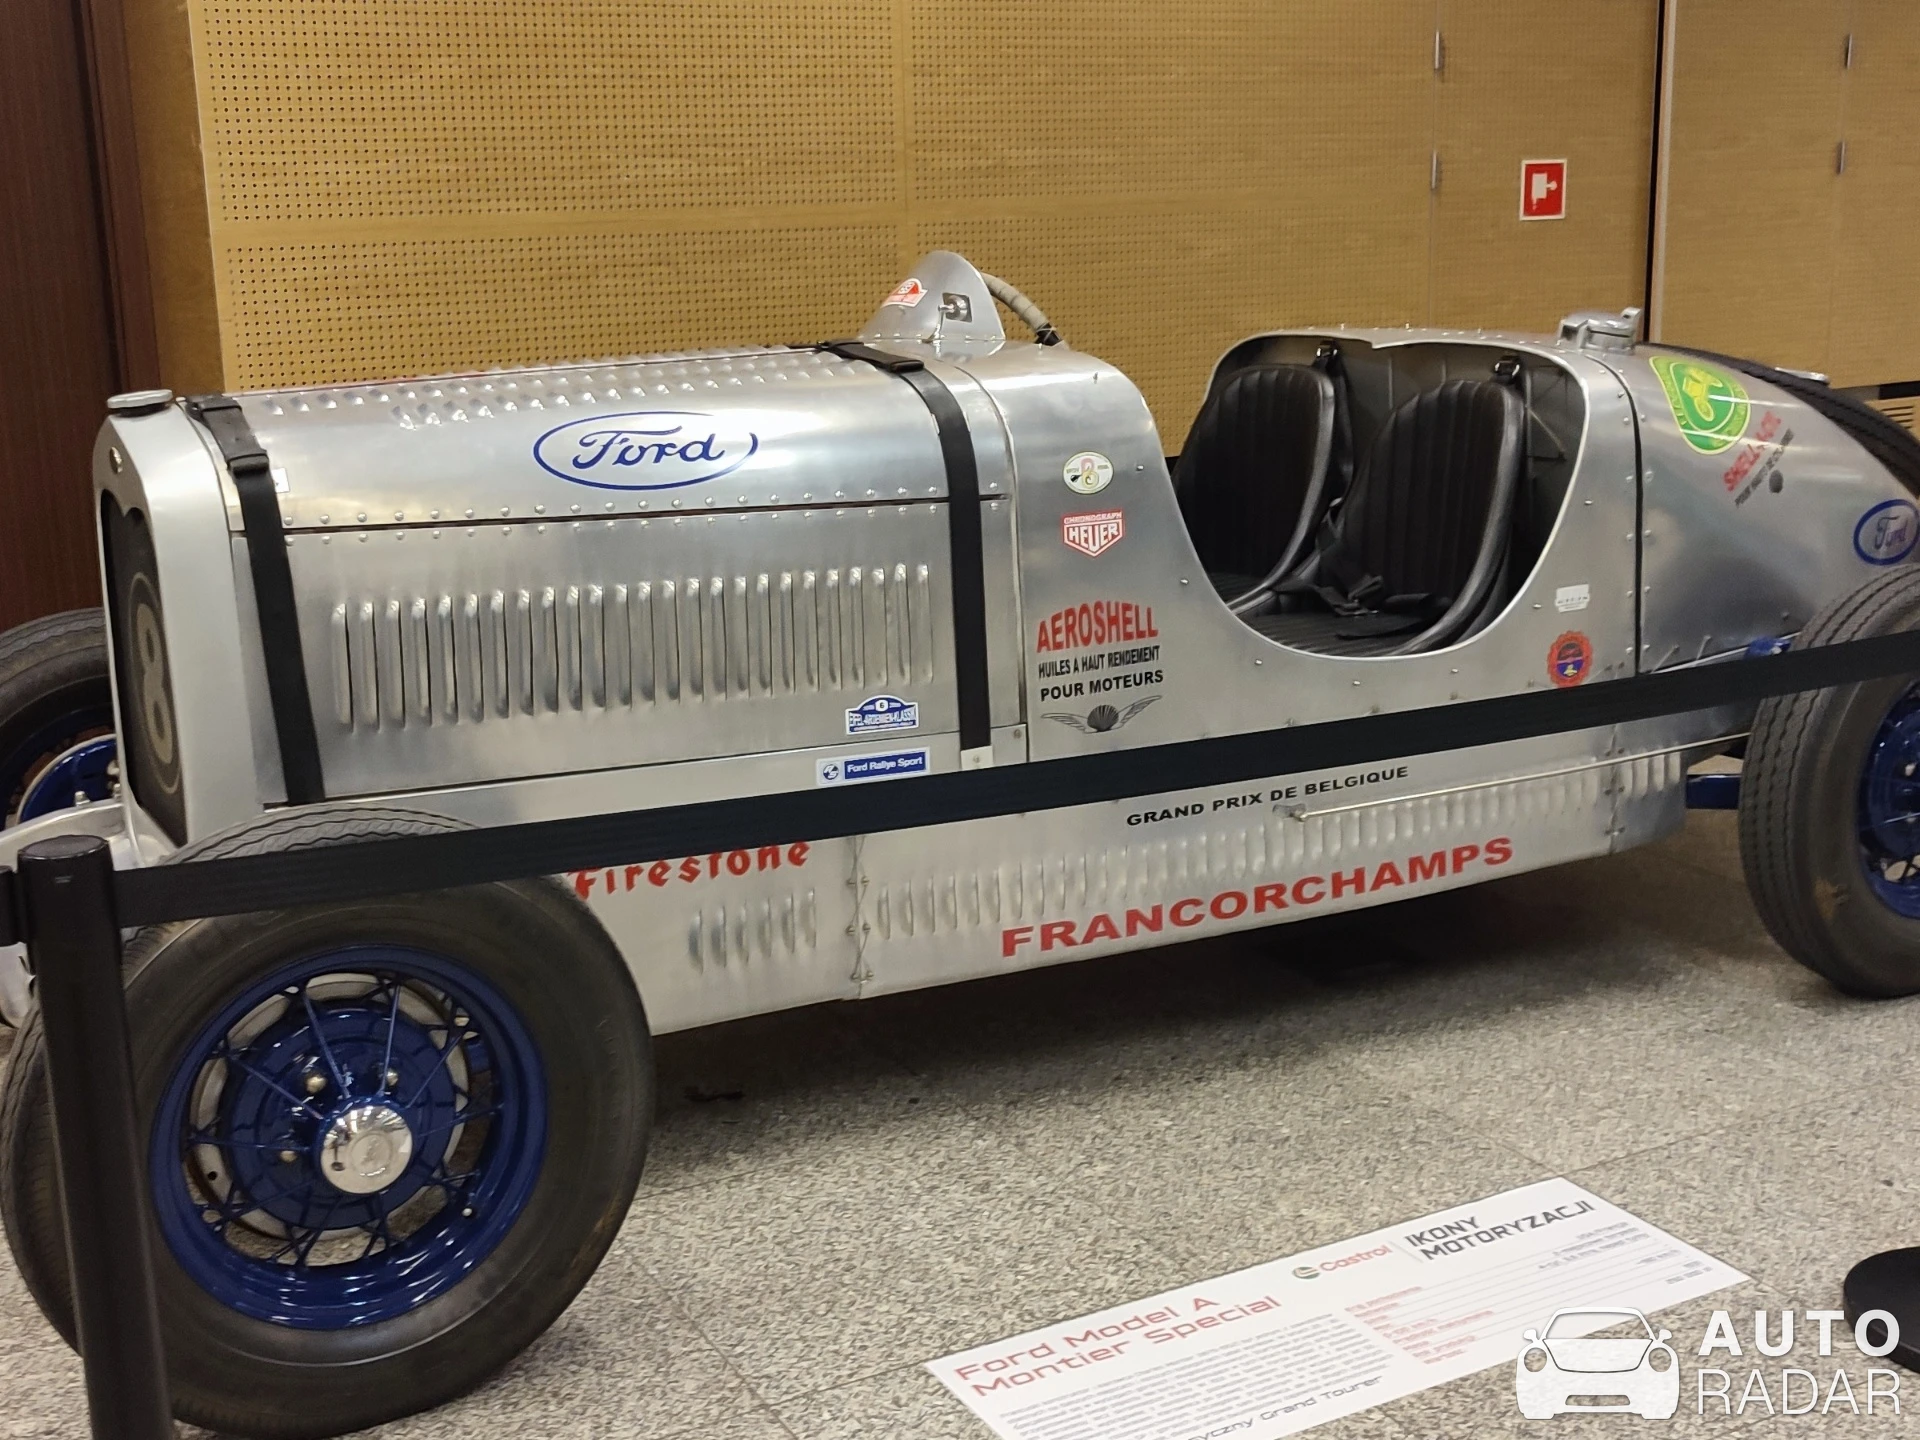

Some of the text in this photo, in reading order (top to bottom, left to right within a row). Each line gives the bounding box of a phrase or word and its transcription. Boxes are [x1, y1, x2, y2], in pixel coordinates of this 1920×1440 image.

[572, 425, 726, 469] Ford
[1063, 511, 1123, 525] CHRONOGRAPH
[1068, 523, 1119, 553] HEUER
[1037, 600, 1159, 653] AEROSHELL
[136, 602, 173, 765] 8
[1038, 659, 1071, 679] HUILES
[1081, 654, 1105, 672] HAUT
[1107, 645, 1160, 668] RENDEMENT
[1040, 669, 1164, 702] POUR MOTEURS
[847, 757, 923, 773] Ford Rallye Sport
[1126, 766, 1409, 826] GRAND PRIX DE BELGIQUE
[568, 841, 811, 900] Firestone
[1002, 837, 1514, 957] FRANCORCHAMPS
[1404, 1216, 1480, 1248] IKONY
[1419, 1200, 1596, 1260] MOTORYZACJI
[1319, 1244, 1394, 1272] Castrol
[954, 1297, 1219, 1380] Ford Model A
[970, 1340, 1131, 1396] Montier
[1144, 1295, 1282, 1344] Special
[1259, 1397, 1318, 1421] Grand
[1320, 1375, 1383, 1400] Tourer
